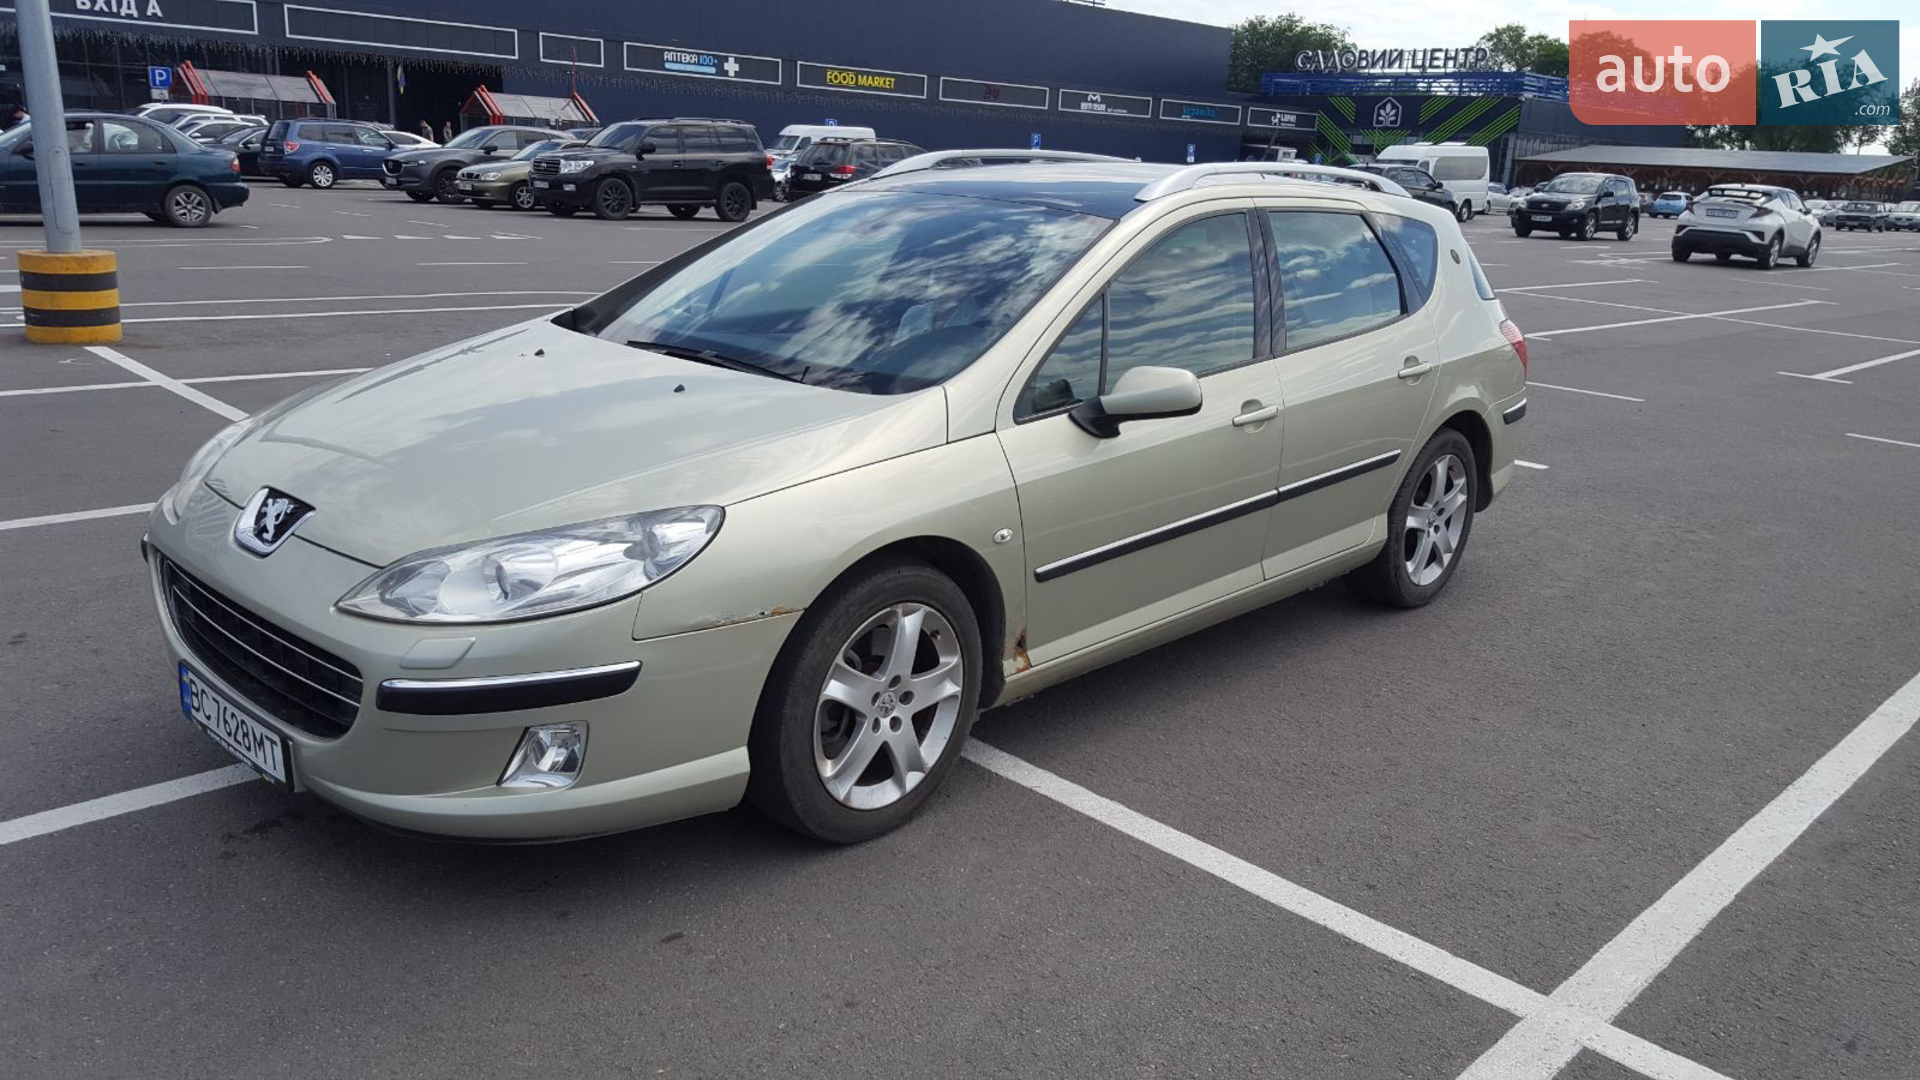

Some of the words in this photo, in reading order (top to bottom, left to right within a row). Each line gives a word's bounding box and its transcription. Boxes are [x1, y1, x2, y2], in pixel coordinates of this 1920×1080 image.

[663, 51, 698, 64] АПТЕКА
[1295, 48, 1404, 73] САДОВИЙ
[1411, 47, 1489, 73] ЦЕНТР
[155, 69, 167, 86] P
[826, 71, 857, 86] FOOD
[857, 74, 895, 90] MARKET
